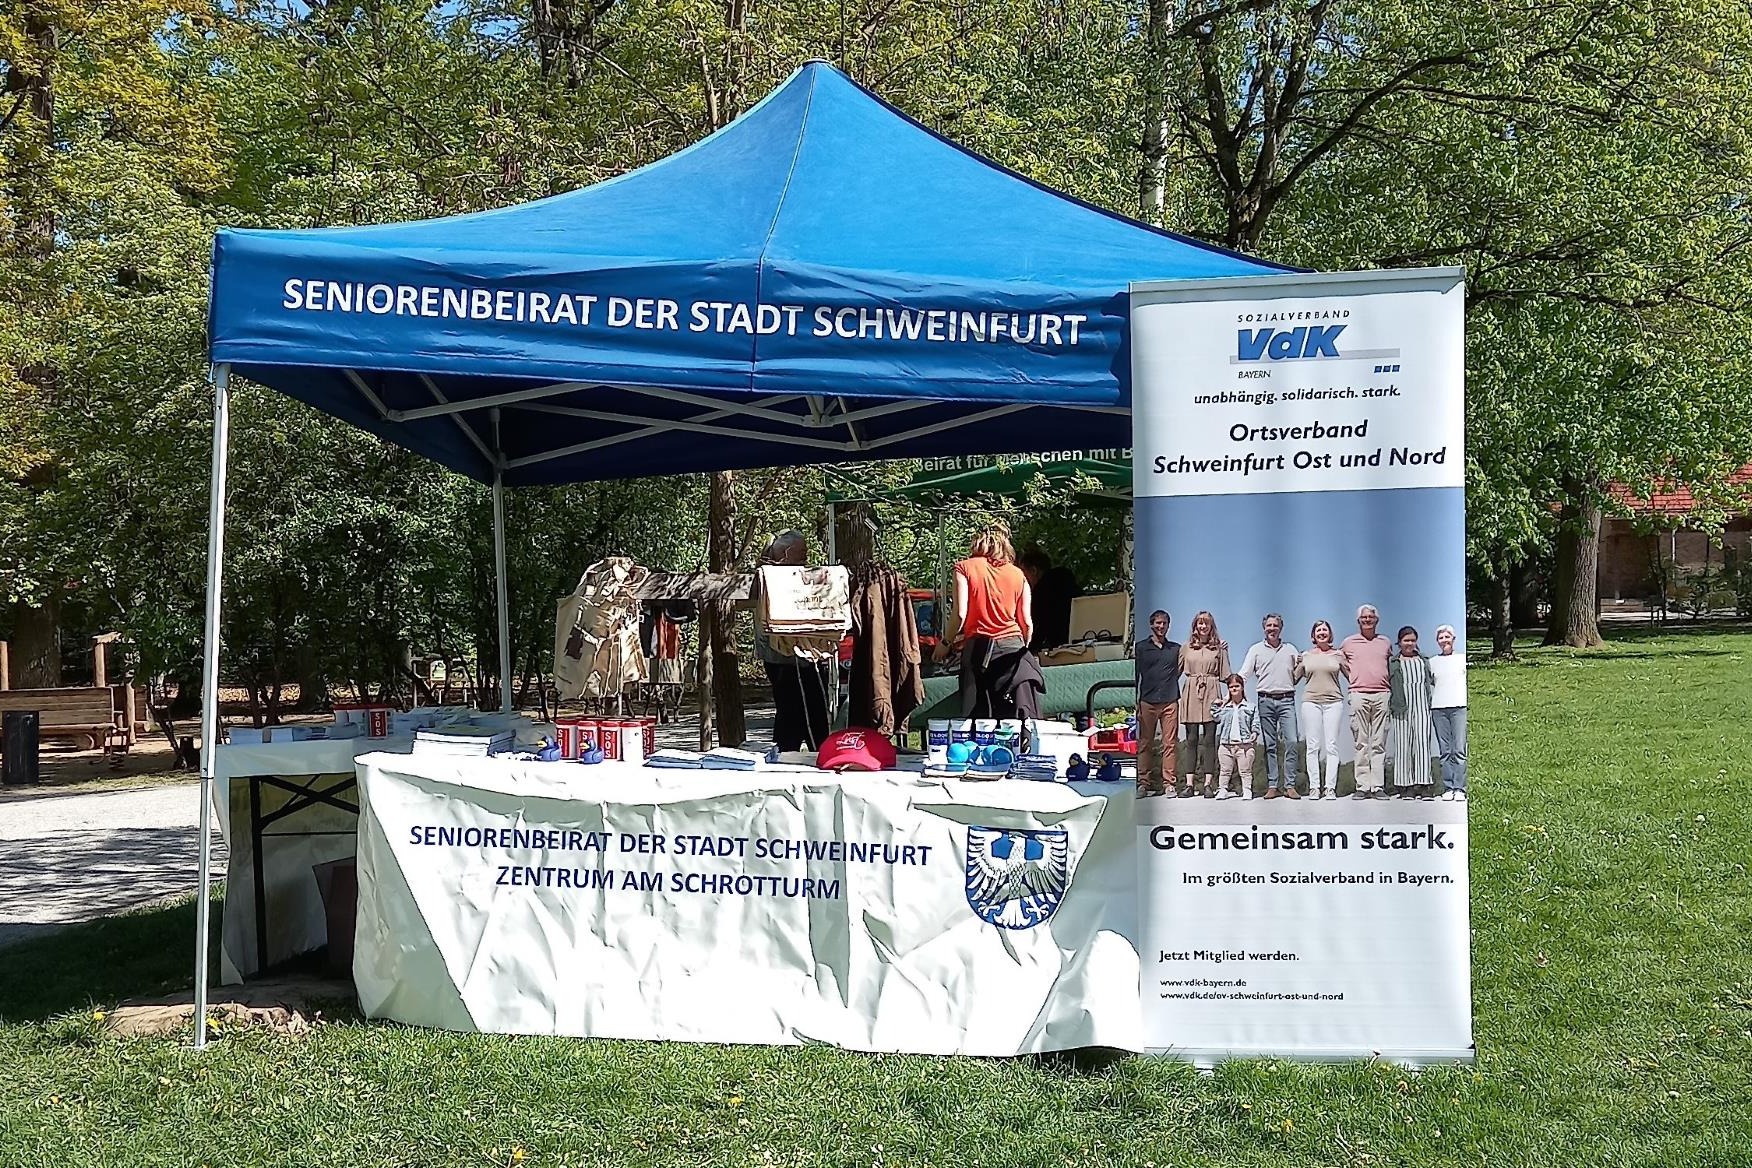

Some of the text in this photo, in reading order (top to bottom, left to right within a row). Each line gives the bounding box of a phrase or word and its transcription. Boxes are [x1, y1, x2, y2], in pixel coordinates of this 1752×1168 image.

[283, 279, 1086, 345] SENIORENBEIRAT DER STADT SCHWEINFURT
[1238, 310, 1351, 323] SOZIALVERBAND
[1237, 325, 1347, 360] VdK
[1238, 370, 1271, 379] BAYERN
[1194, 385, 1401, 406] unabhängig. solidarisch. stark.
[1229, 420, 1368, 442] Ortsverband
[1153, 447, 1446, 476] Schweinfurt Ost und Nord
[604, 731, 612, 758] SOS
[409, 825, 933, 866] SENIORENBEIRAT DER STADT SCHWEINFURT
[1150, 824, 1454, 850] Gemeinsam stark.
[496, 866, 840, 899] ZENTRUM AM SCHROTTURM
[1182, 872, 1454, 886] Im größten Sozialverband in Bayern.
[1159, 951, 1299, 963] Jetzt Mitglied werden.
[1160, 979, 1247, 988] www.vdk-bayern.de
[1160, 991, 1343, 1001] www.vdk.de/ov-schweinfurt-ost-und-nord
